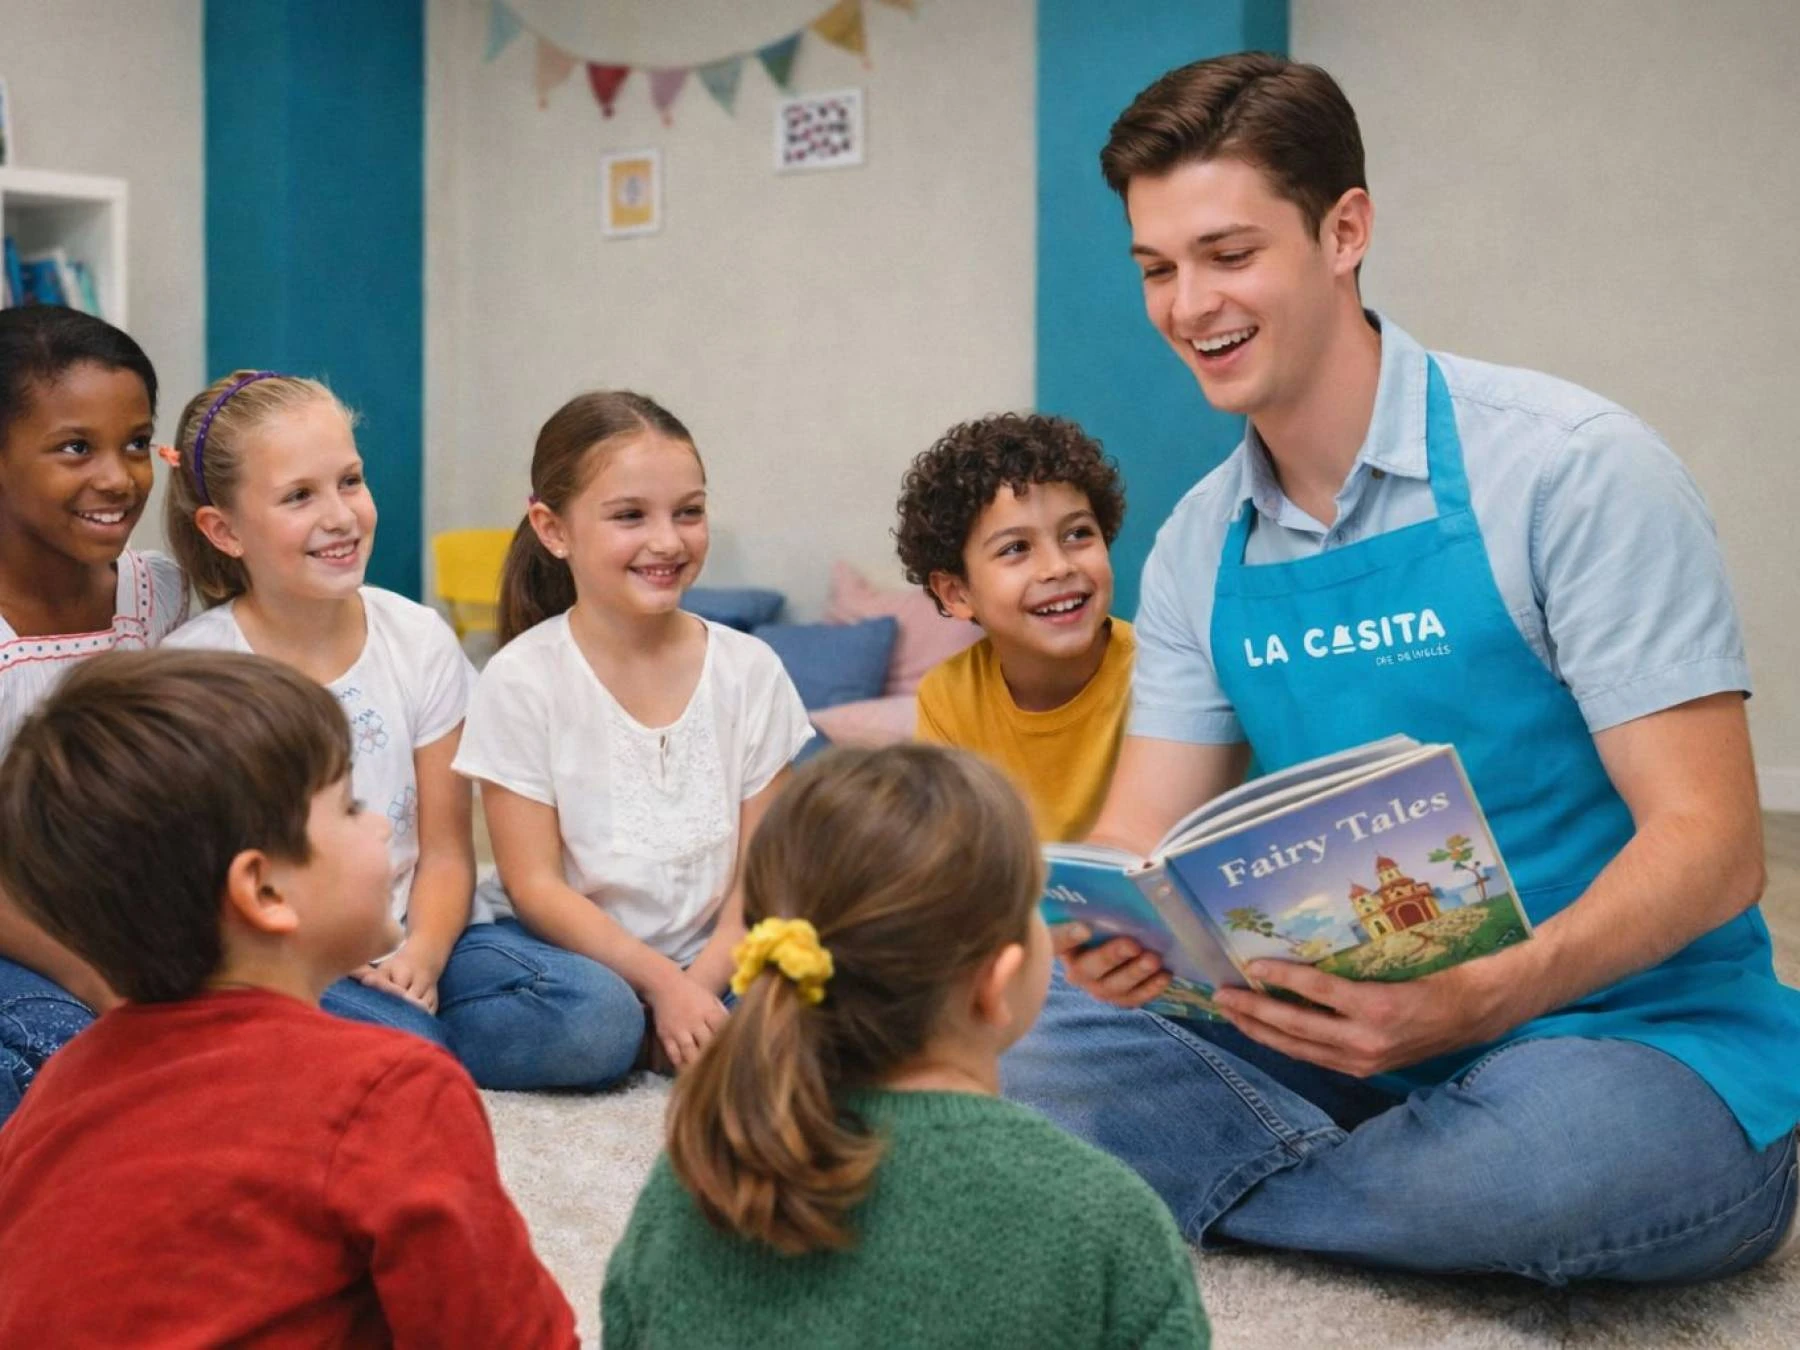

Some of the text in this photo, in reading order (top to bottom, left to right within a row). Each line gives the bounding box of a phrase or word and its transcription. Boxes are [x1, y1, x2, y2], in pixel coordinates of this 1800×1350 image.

[1244, 634, 1289, 667] LA
[1218, 792, 1449, 888] Fairy Tales
